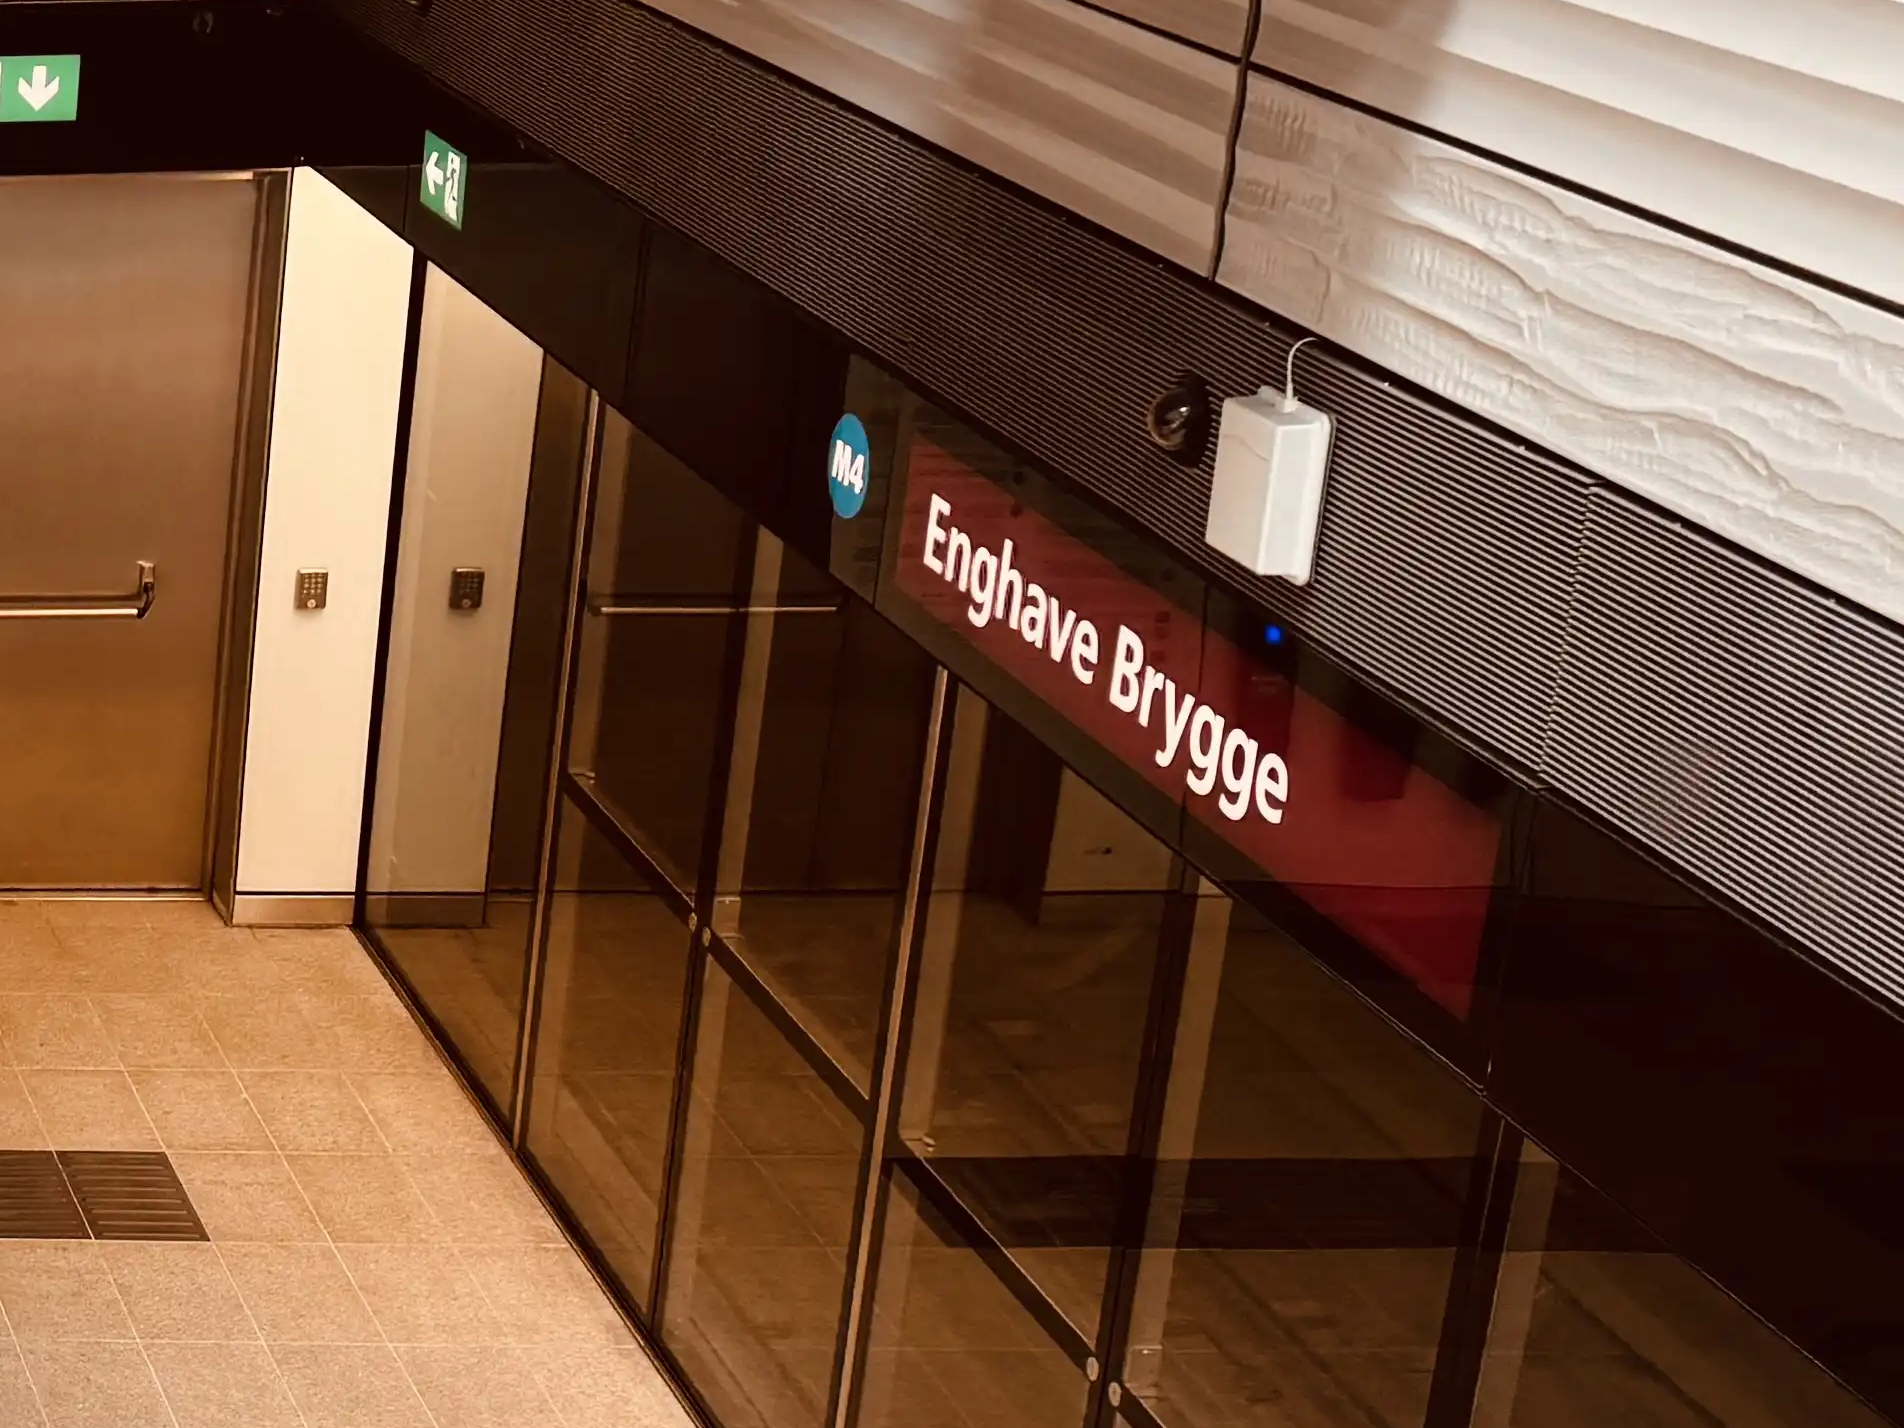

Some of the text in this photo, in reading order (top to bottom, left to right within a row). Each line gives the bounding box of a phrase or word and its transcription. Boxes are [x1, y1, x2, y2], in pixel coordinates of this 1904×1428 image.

[830, 439, 865, 495] M4
[923, 493, 1289, 825] Enghave Brygge
